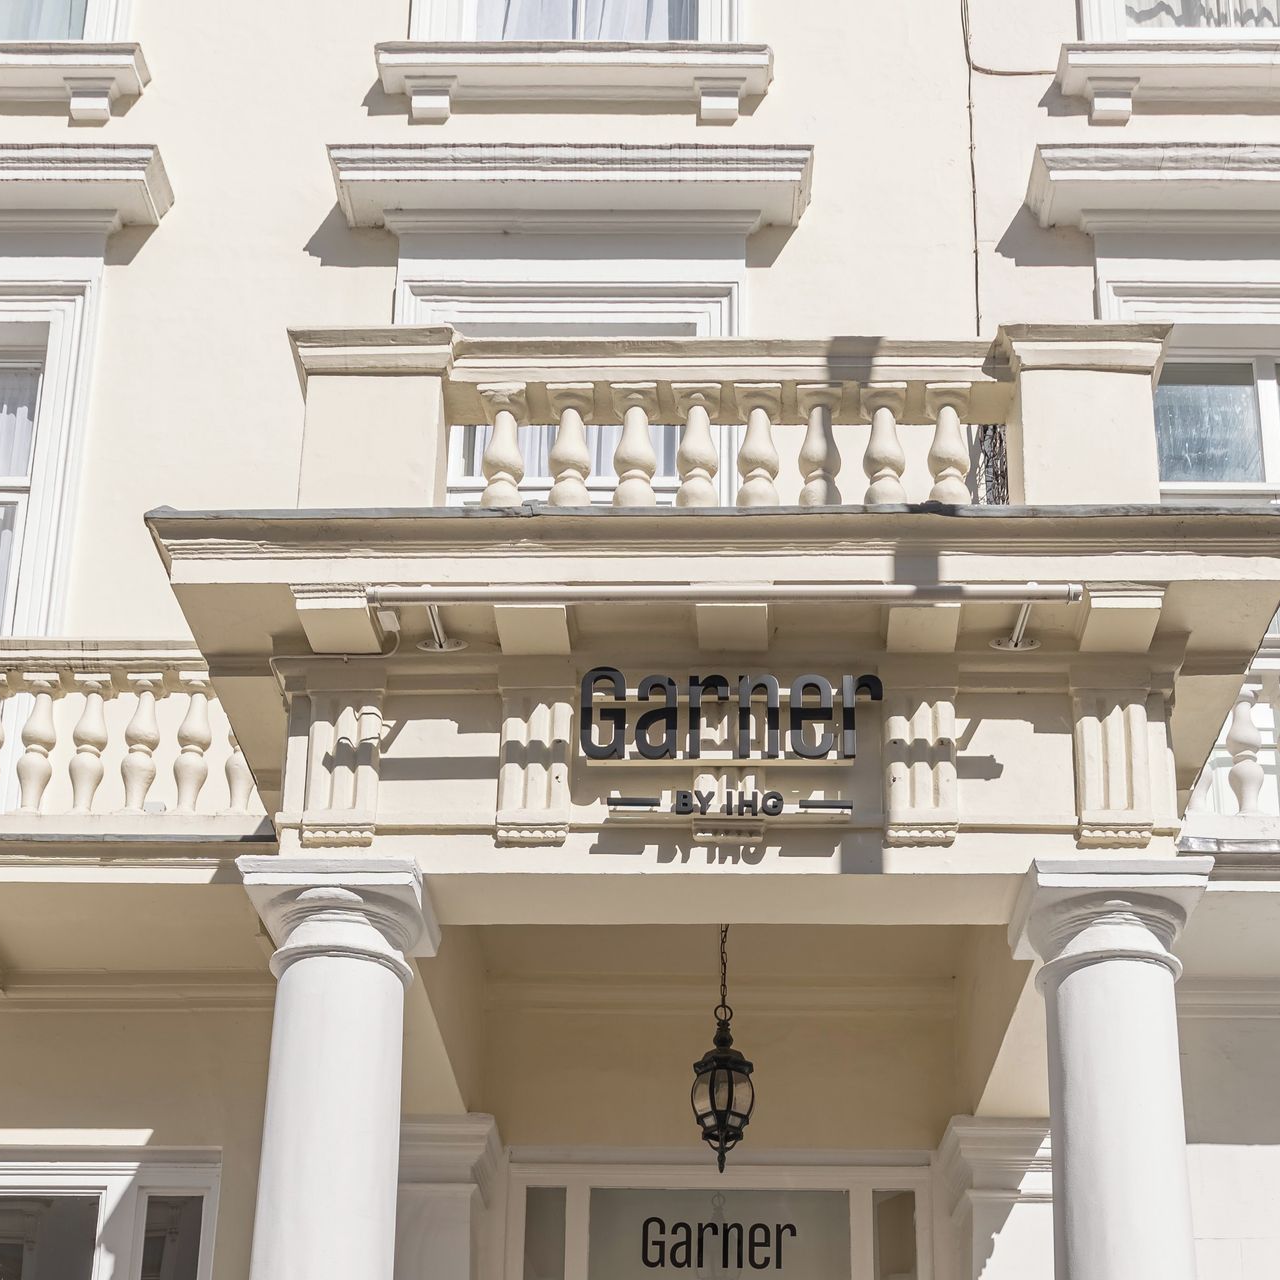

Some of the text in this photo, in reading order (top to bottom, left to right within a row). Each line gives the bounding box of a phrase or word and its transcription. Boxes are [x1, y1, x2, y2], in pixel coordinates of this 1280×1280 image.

[580, 666, 884, 760] Garner
[675, 790, 784, 816] BY IHG
[641, 1216, 797, 1270] Garner
